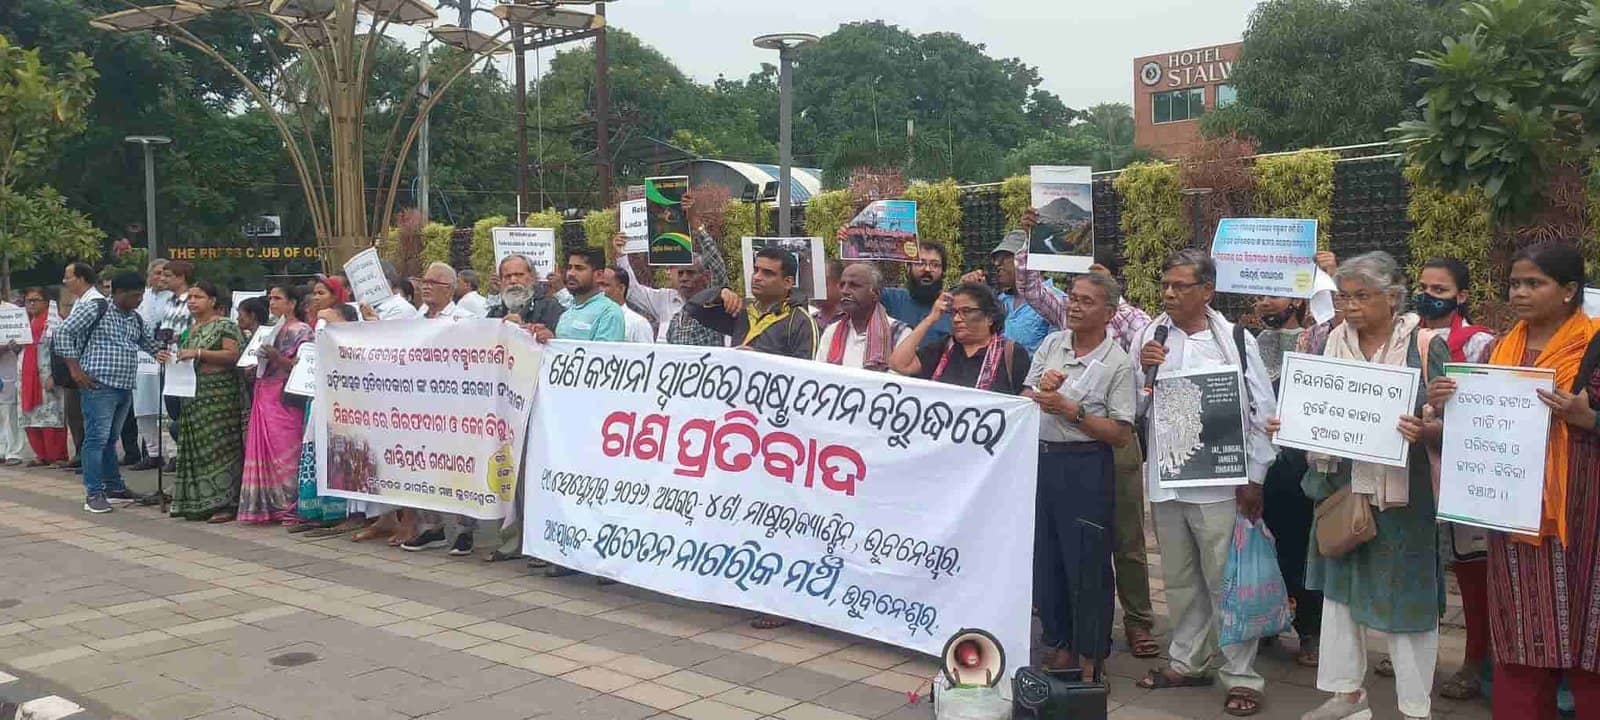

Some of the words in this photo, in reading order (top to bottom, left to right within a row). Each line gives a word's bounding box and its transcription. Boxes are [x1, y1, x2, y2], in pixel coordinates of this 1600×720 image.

[1168, 47, 1224, 69] HOTEL
[168, 247, 196, 259] THE
[284, 246, 301, 258] OF
[549, 347, 586, 387] ଖଣି
[584, 351, 655, 393] କମ୍ପାନୀ
[794, 379, 866, 425] ଦମନ
[868, 382, 1006, 456] ବିରୁଦ୍ଧରେ
[1293, 369, 1344, 391] ନିୟମଗିରି
[1347, 380, 1383, 398] ଆମର
[601, 410, 671, 462] ଗଣ
[673, 410, 867, 497] ପ୍ରତିବାଦ
[673, 539, 783, 591] ନାଗରିକ
